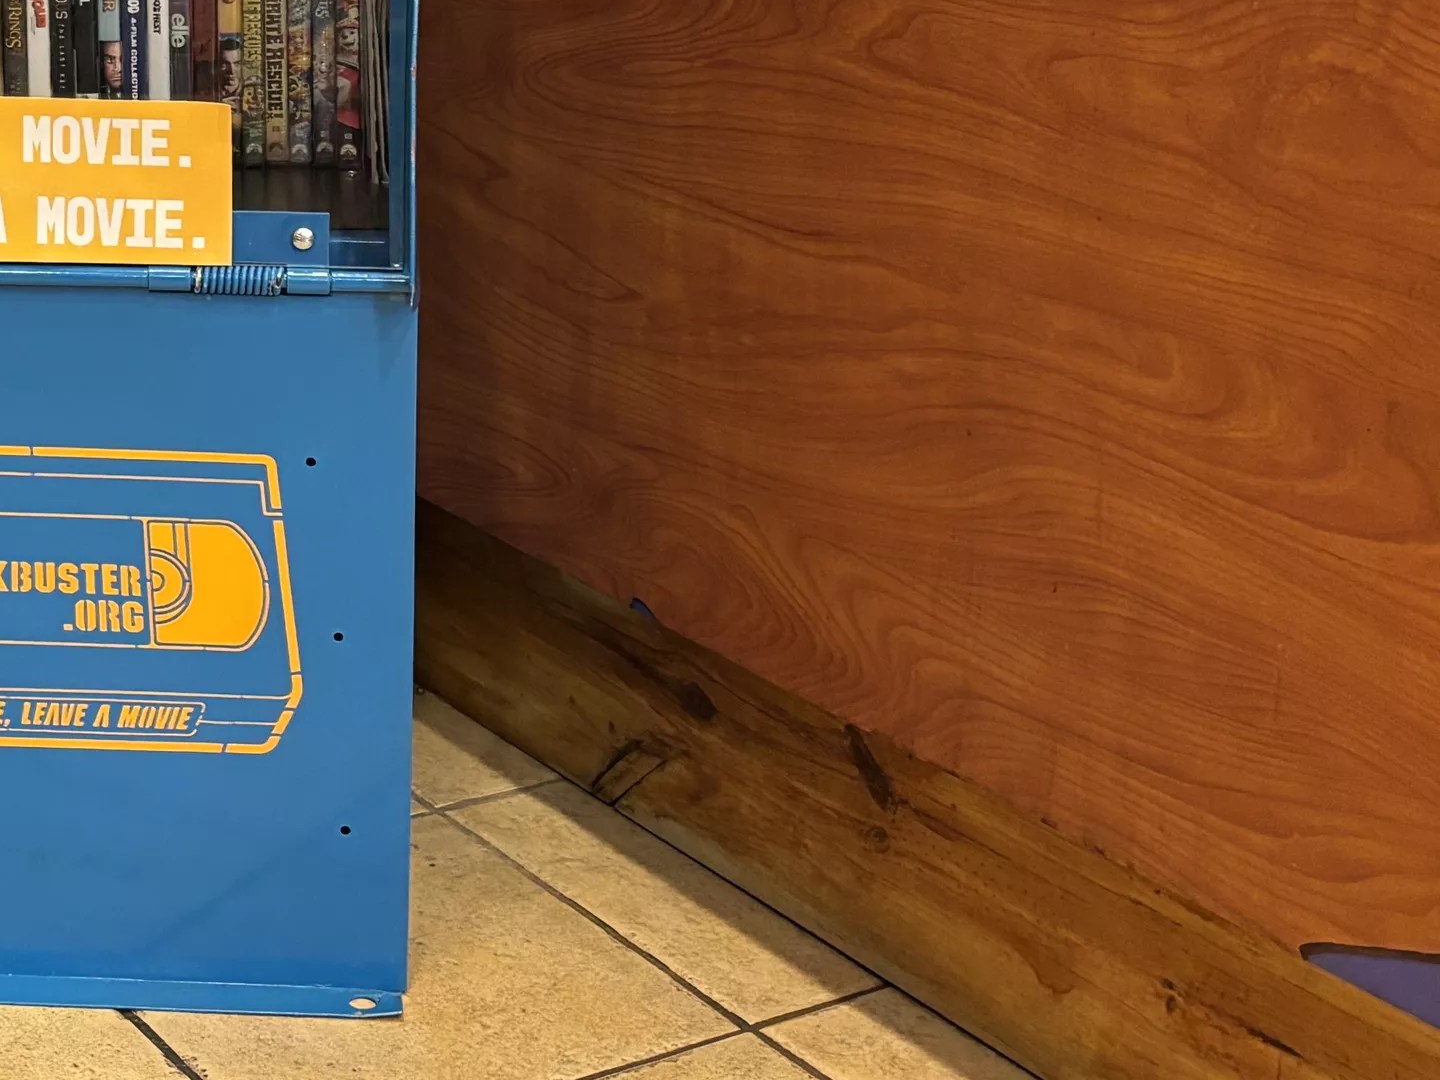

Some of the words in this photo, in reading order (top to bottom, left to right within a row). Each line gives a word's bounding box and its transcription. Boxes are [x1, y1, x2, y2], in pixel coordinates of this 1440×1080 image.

[5, 7, 22, 49] RINGS
[153, 13, 162, 34] NEST
[171, 13, 190, 48] elle
[243, 13, 261, 61] RESCUES
[266, 47, 285, 119] RESCUE!
[23, 115, 191, 168] MOVIE.
[37, 196, 205, 249] MOVIE.
[63, 599, 145, 633] .ORG
[22, 702, 86, 726] LEAVE
[93, 704, 110, 728] A
[117, 705, 195, 730] MOVIE
